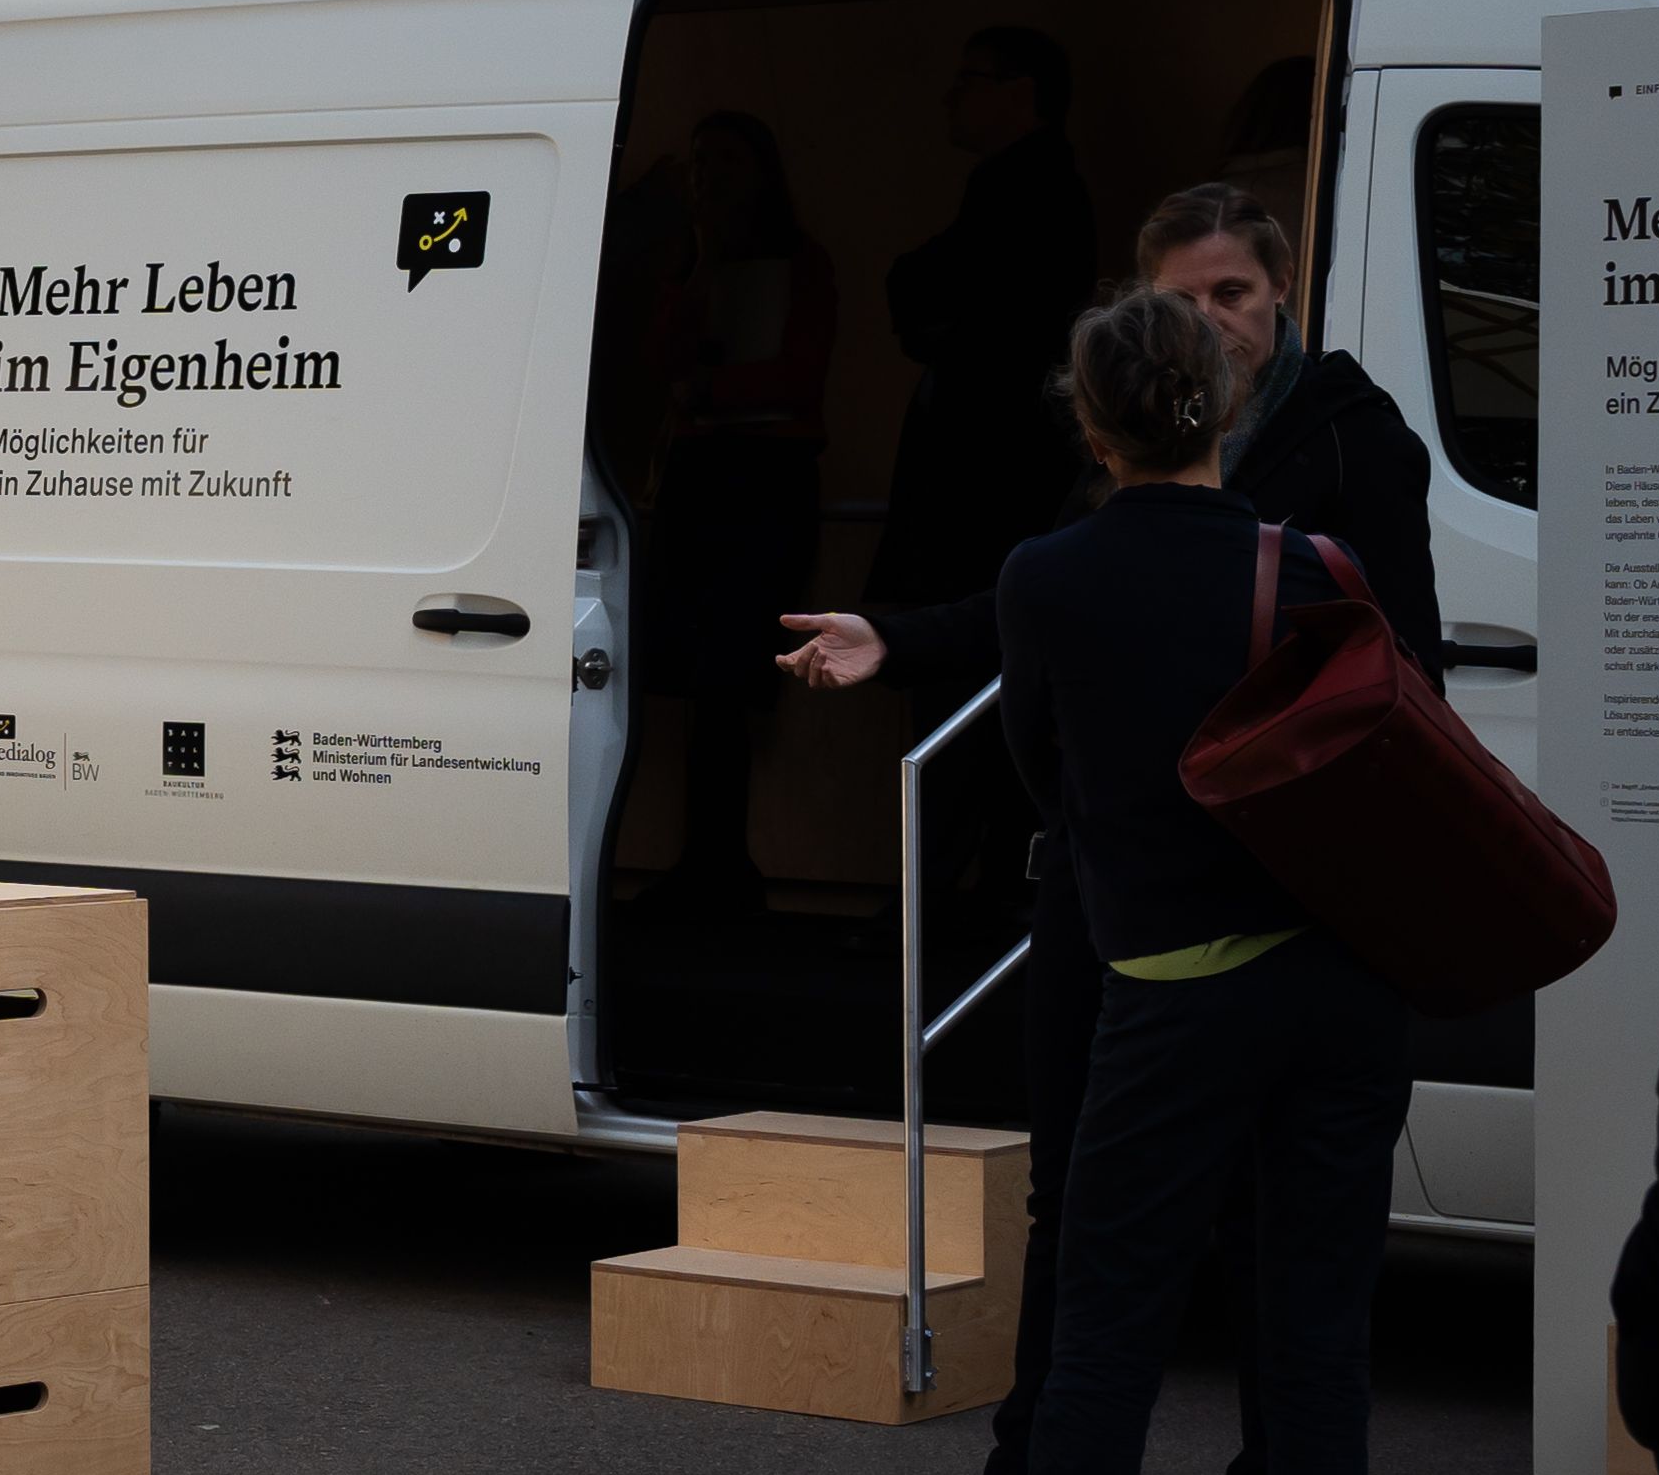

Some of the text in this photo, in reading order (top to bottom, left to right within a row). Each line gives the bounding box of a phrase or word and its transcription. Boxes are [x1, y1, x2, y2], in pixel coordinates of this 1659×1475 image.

[142, 260, 296, 313] Leben
[66, 335, 339, 407] Eigenheim
[1606, 392, 1639, 414] ein
[173, 427, 208, 453] für
[1605, 465, 1614, 474] In
[25, 469, 132, 496] Zuhause
[141, 469, 180, 495] mit
[188, 470, 291, 496] Zukunft
[1605, 481, 1631, 491] Diese
[1640, 498, 1659, 509] des
[1605, 515, 1622, 524] das
[1625, 514, 1654, 523] Leben
[1605, 563, 1620, 572] Die
[1633, 579, 1648, 592] Ob
[1603, 613, 1621, 621] Von
[1624, 613, 1640, 624] der
[1604, 629, 1619, 637] Mit
[312, 732, 442, 753] Baden-Württemberg
[313, 750, 540, 775] Ministerium für Landesentwicklung
[72, 763, 100, 782] BW
[313, 769, 391, 783] und Wohnen
